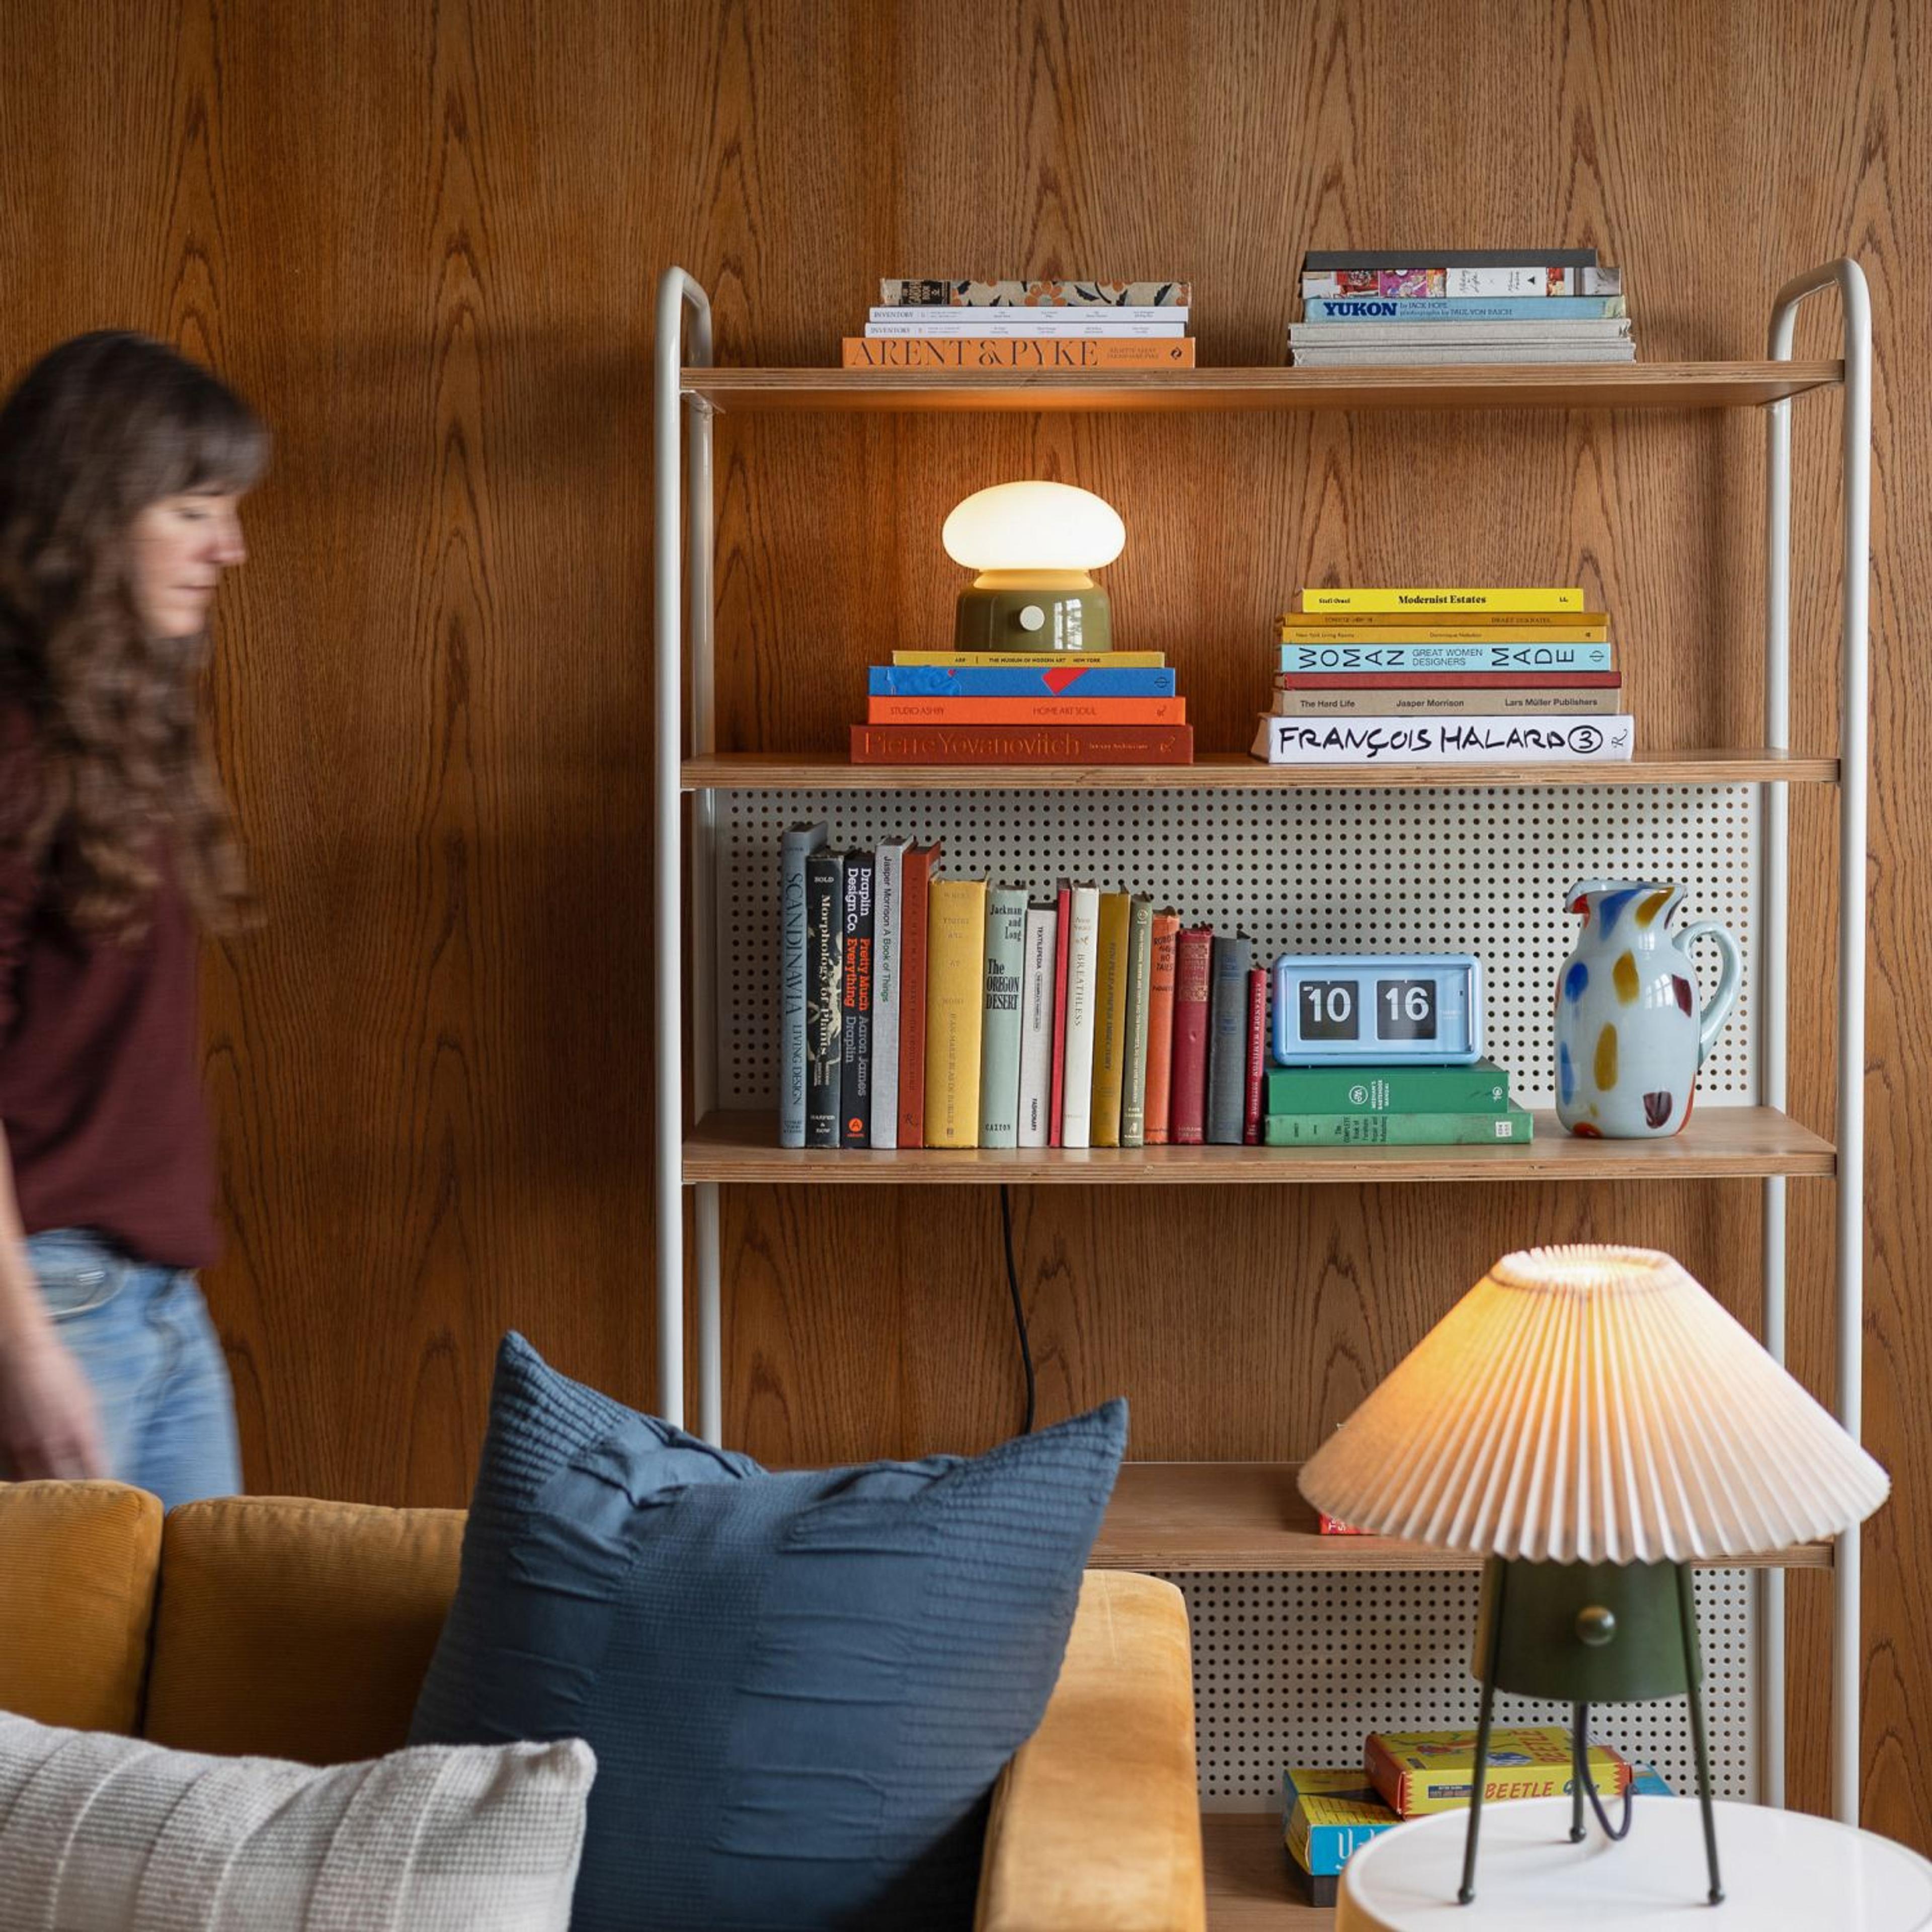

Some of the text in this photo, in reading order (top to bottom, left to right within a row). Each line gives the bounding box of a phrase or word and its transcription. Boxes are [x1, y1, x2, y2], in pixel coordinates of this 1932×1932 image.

[1323, 302, 1398, 316] YUKON
[1399, 596, 1486, 604] Modernist Estates
[1299, 648, 1405, 669] WOMAN
[1412, 658, 1466, 666] DESIGNERS
[1491, 648, 1574, 666] MADE
[1397, 700, 1424, 708] Jasper
[1525, 698, 1550, 706] Müller
[1553, 698, 1597, 706] Publishers
[1279, 727, 1432, 757] FRANÇOIS
[1441, 726, 1566, 753] HALARD
[847, 868, 858, 934] Design Co.
[860, 868, 871, 916] Draplin
[990, 905, 1022, 916] Jackman
[1008, 917, 1021, 928] and
[785, 873, 803, 1015] SCANDINAVIA
[1005, 926, 1021, 941] Long
[820, 895, 831, 1055] Morphology of Plants
[845, 938, 856, 1008] Everything
[859, 938, 870, 1011] Pretty Much
[882, 962, 889, 971] of
[988, 959, 1004, 974] The
[987, 977, 1019, 992] OREGON
[1074, 954, 1085, 1026] BREATHLESS
[986, 995, 1018, 1009] DESERT
[1308, 988, 1351, 1022] 10
[1386, 987, 1429, 1020] 16
[793, 1025, 802, 1063] LIVING
[845, 1017, 856, 1063] Draplin
[858, 1016, 866, 1096] Aaron James
[793, 1067, 802, 1106] DESIGN
[1485, 1781, 1554, 1799] BEETLE
